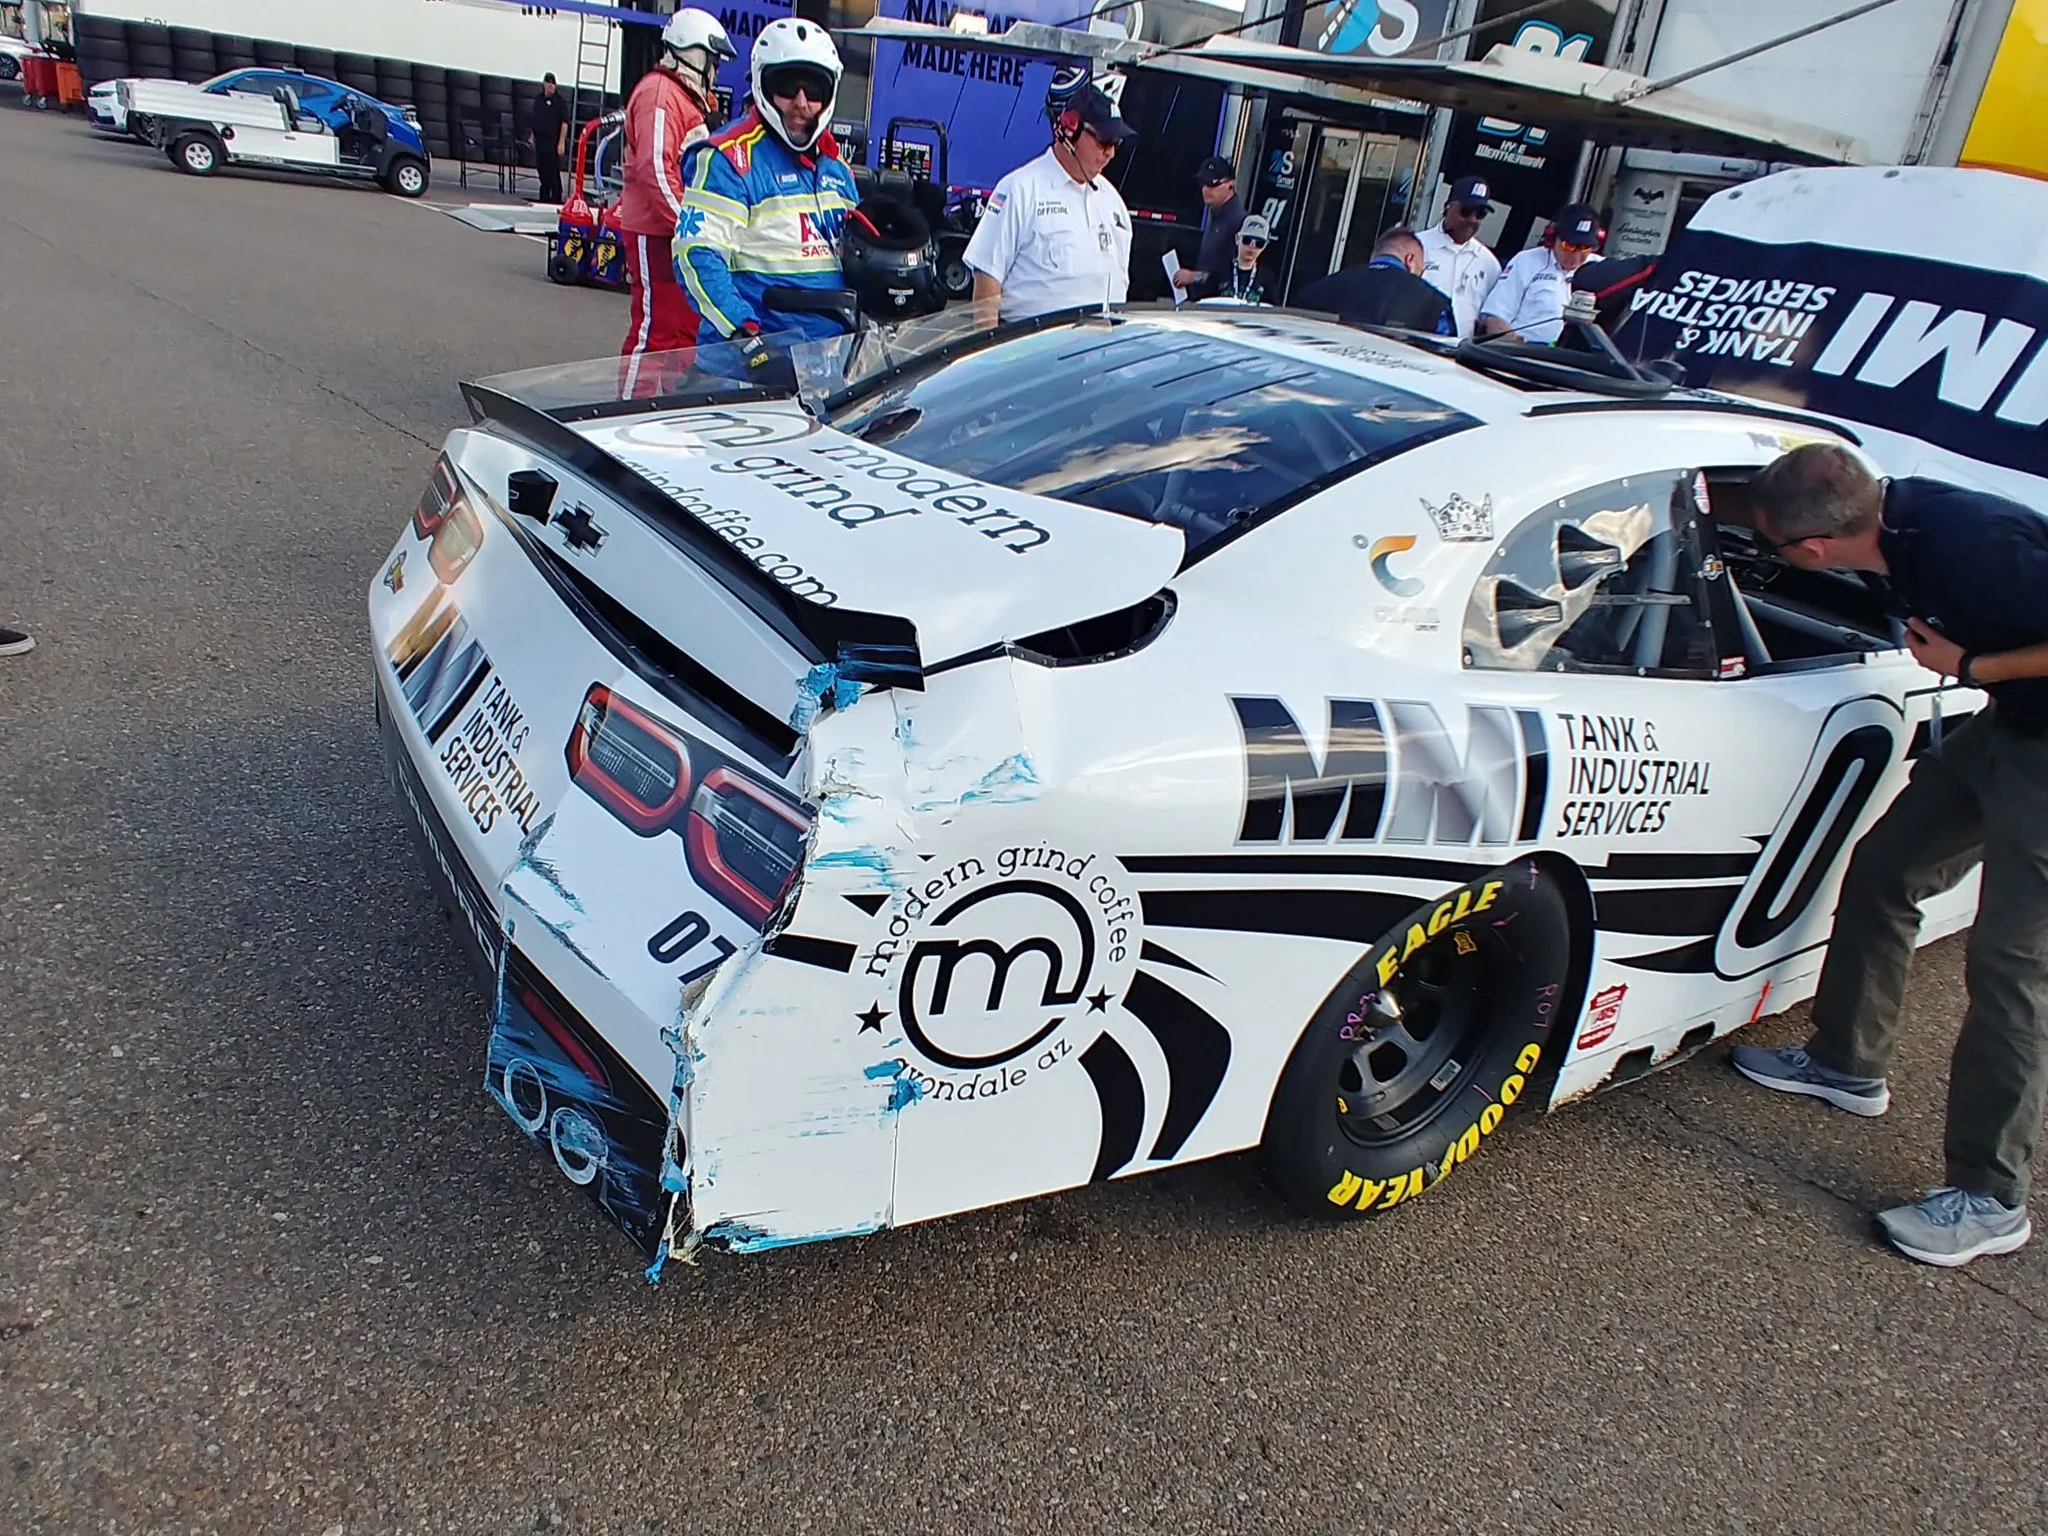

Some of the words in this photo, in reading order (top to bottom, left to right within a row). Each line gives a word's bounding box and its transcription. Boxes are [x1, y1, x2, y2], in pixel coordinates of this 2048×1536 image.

[720, 7, 778, 39] MAD
[903, 41, 966, 77] MADE
[969, 50, 1032, 88] HERE
[1630, 288, 1817, 338] INDUSTRIA
[1673, 270, 1837, 312] SERVICES
[1675, 327, 1701, 350] &
[1696, 329, 1800, 367] TANK
[709, 456, 923, 529] grind
[809, 444, 1051, 555] modern
[481, 675, 524, 743] TANK
[511, 725, 530, 755] &
[1556, 711, 1641, 753] TANK
[1643, 720, 1660, 753] &
[440, 735, 503, 834] SERVICES
[462, 707, 541, 836] INDUSTRIAL
[1224, 692, 1551, 847] MMI
[1568, 755, 1712, 796] INDUSTRIAL
[1556, 799, 1672, 838] SERVICES
[865, 857, 985, 978] modern
[997, 840, 1097, 881] grind
[1090, 874, 1134, 963] coffee
[1375, 881, 1504, 988] EAGLE
[647, 910, 739, 986] 07
[891, 1056, 1028, 1101] avondale
[1037, 1038, 1074, 1070] az
